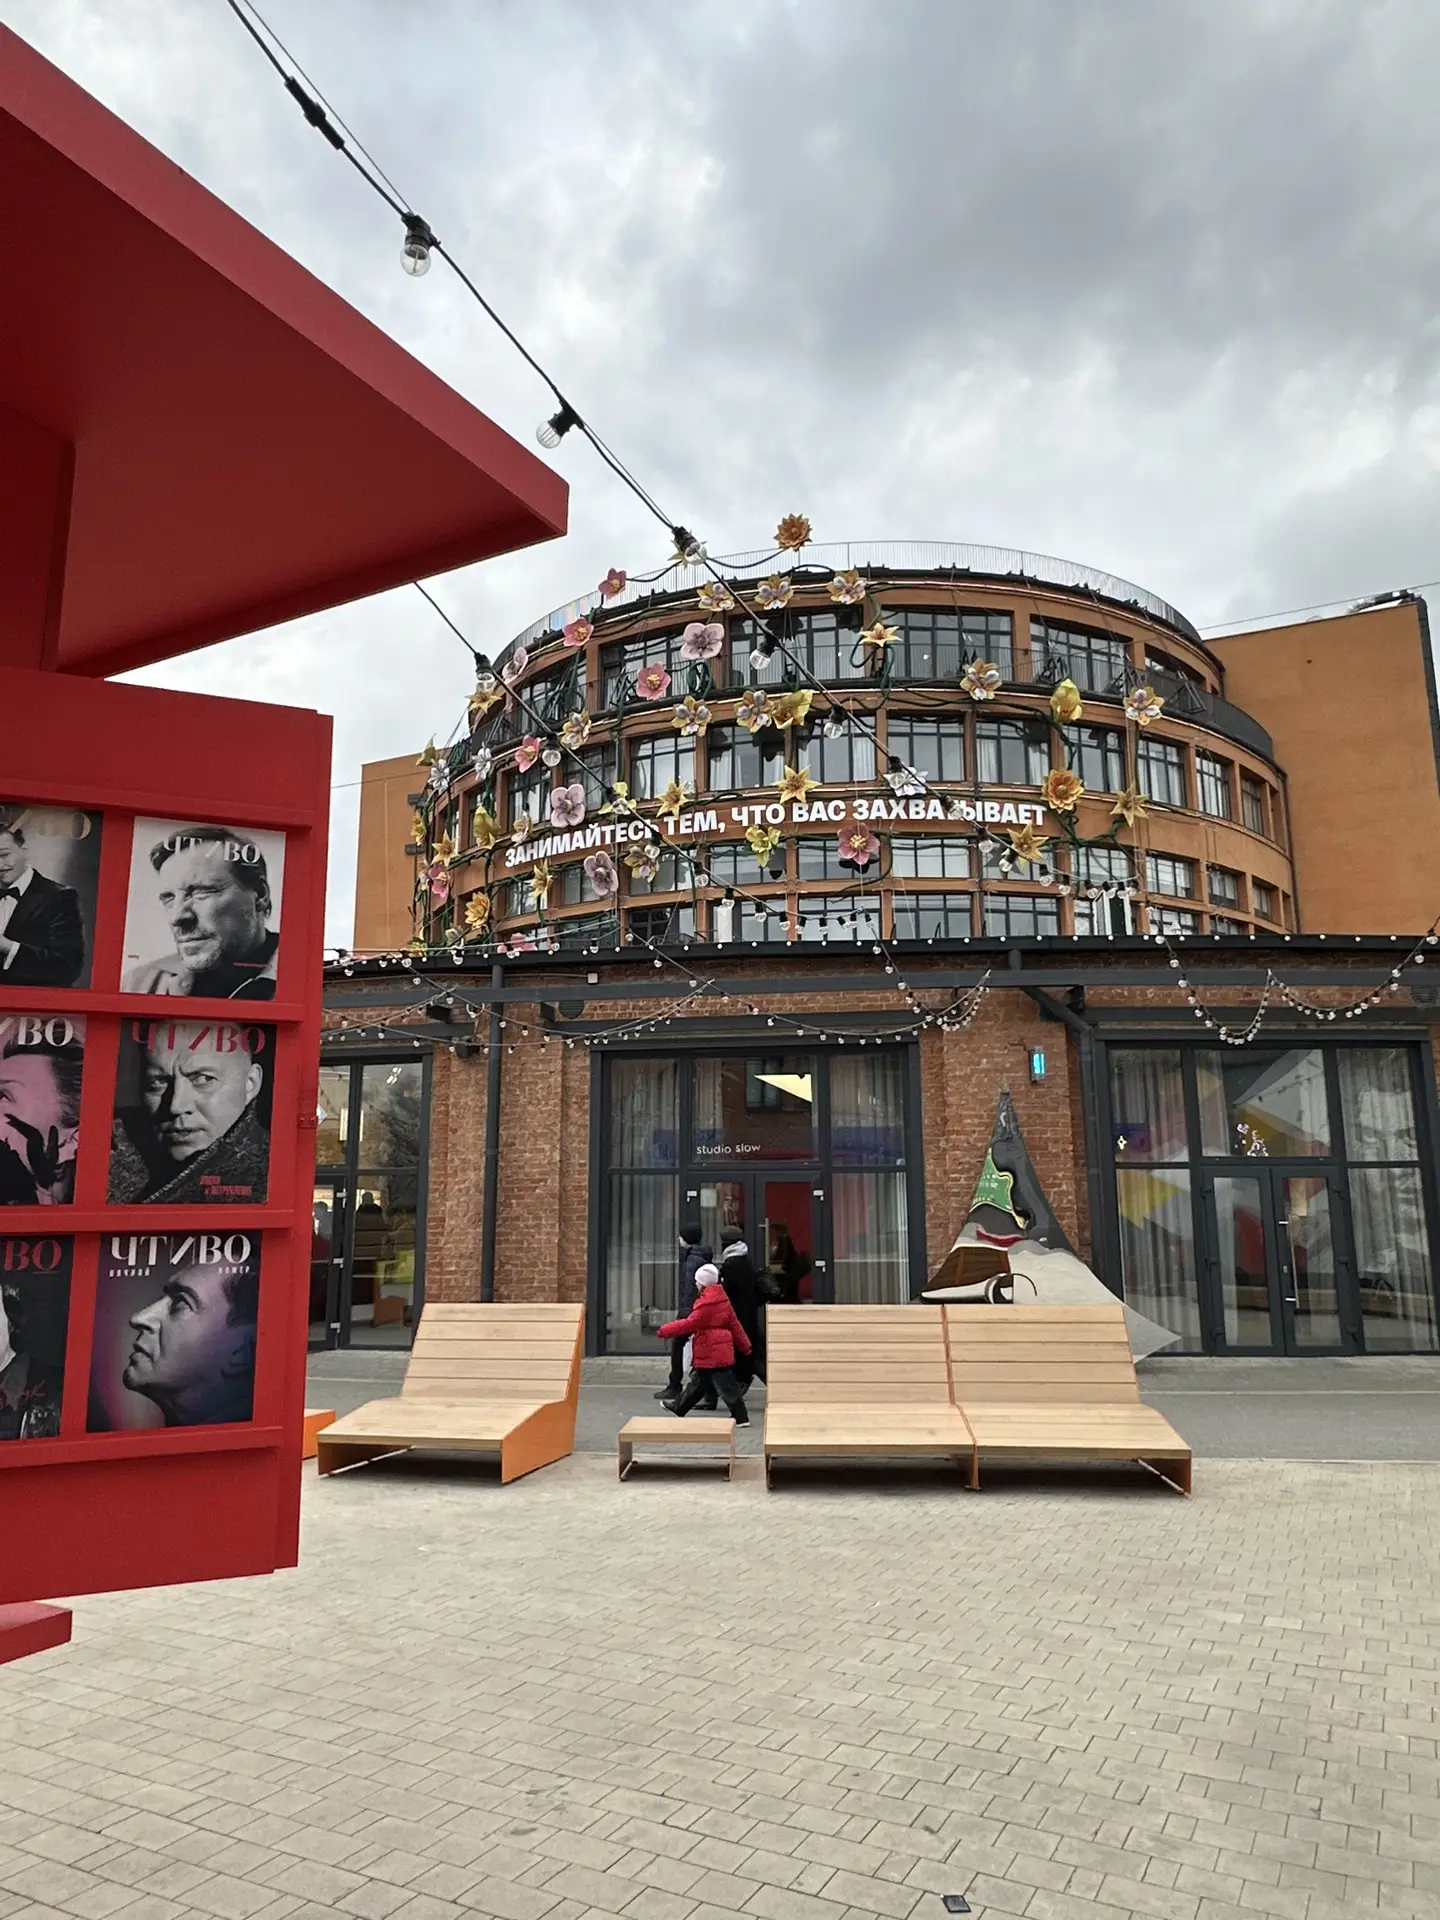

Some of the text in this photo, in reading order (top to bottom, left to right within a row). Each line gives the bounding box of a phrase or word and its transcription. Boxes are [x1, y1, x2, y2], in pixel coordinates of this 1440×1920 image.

[504, 818, 660, 868] ЗАНИМАЙТЕСЬ
[664, 809, 725, 836] ТЕМ,
[732, 803, 786, 827] ЧТО
[792, 800, 846, 823] ВАС
[696, 1143, 761, 1155] studio slow
[111, 1234, 251, 1266] ЧТИВО
